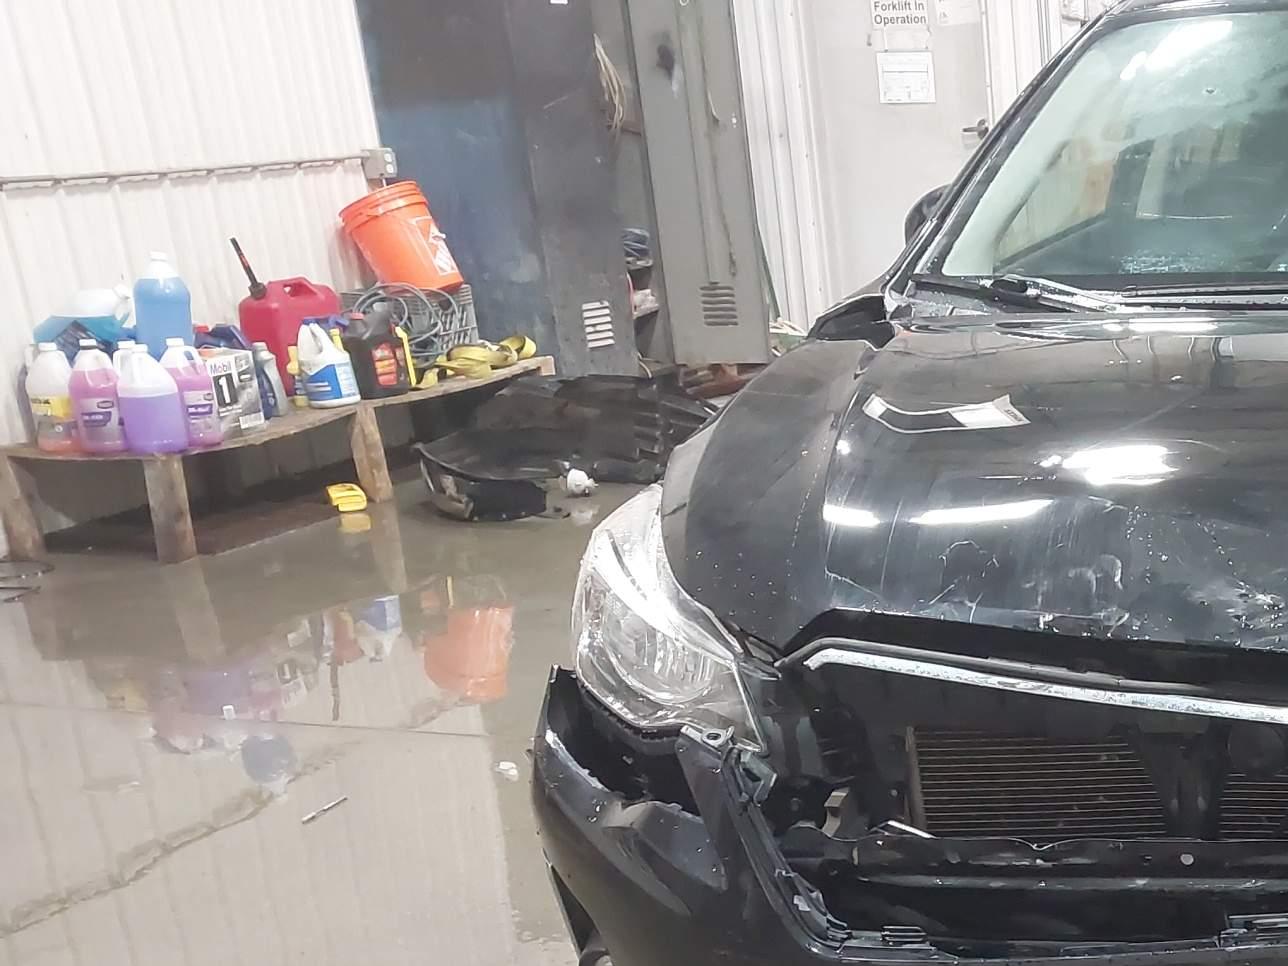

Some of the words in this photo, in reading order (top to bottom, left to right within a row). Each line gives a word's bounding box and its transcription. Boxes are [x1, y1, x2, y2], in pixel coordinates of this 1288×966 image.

[873, 1, 912, 11] Forklift
[914, 1, 925, 11] In
[873, 14, 927, 26] Operation
[210, 361, 232, 375] Mobil
